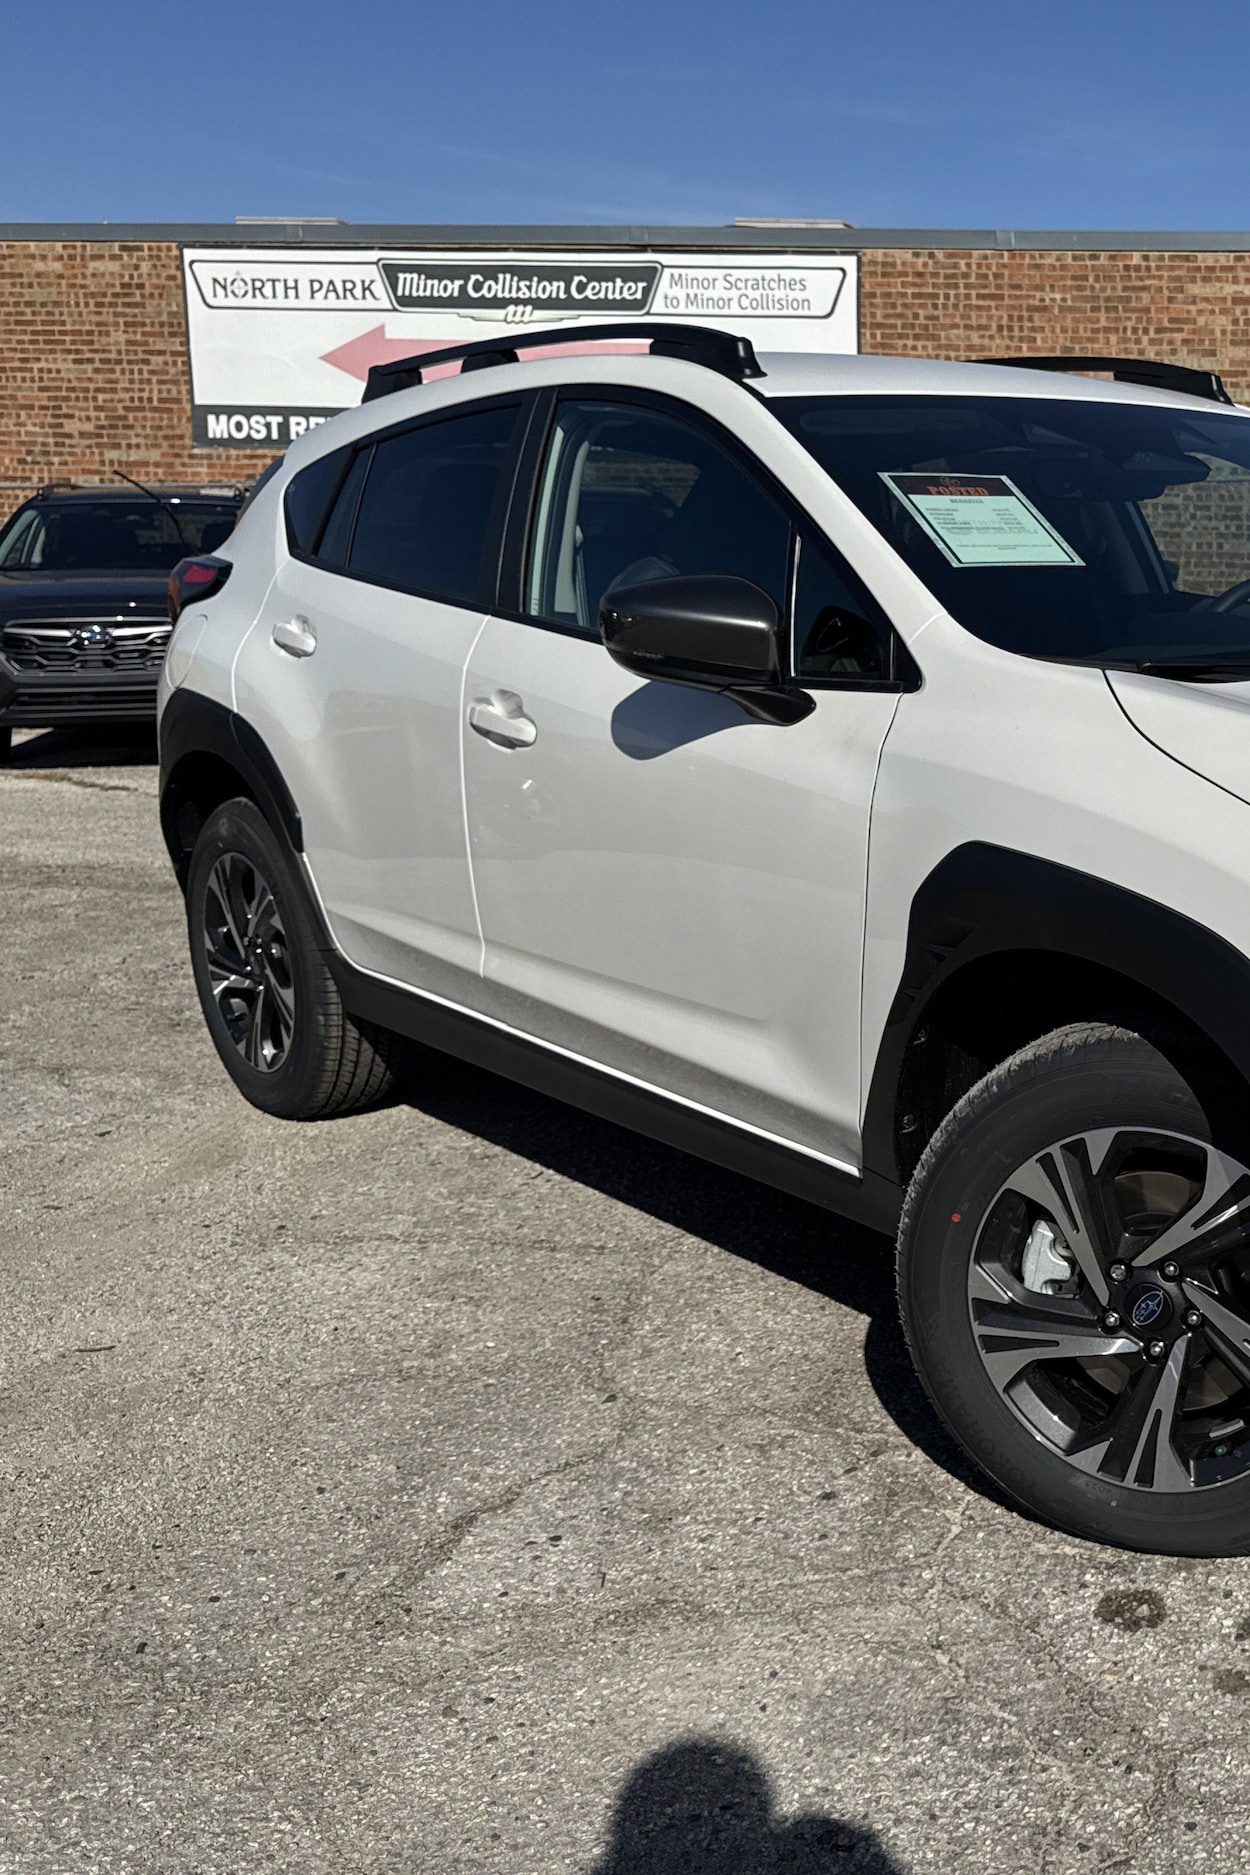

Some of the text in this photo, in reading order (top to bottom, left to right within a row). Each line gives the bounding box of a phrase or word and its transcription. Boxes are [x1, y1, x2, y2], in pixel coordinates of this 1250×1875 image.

[212, 277, 381, 300] NORTH PARK
[397, 272, 647, 300] Minor Collision Center
[669, 273, 807, 291] Minor Scratches
[664, 293, 811, 311] to Minor Collision
[207, 414, 283, 440] MOST
[926, 485, 989, 496] POSTED
